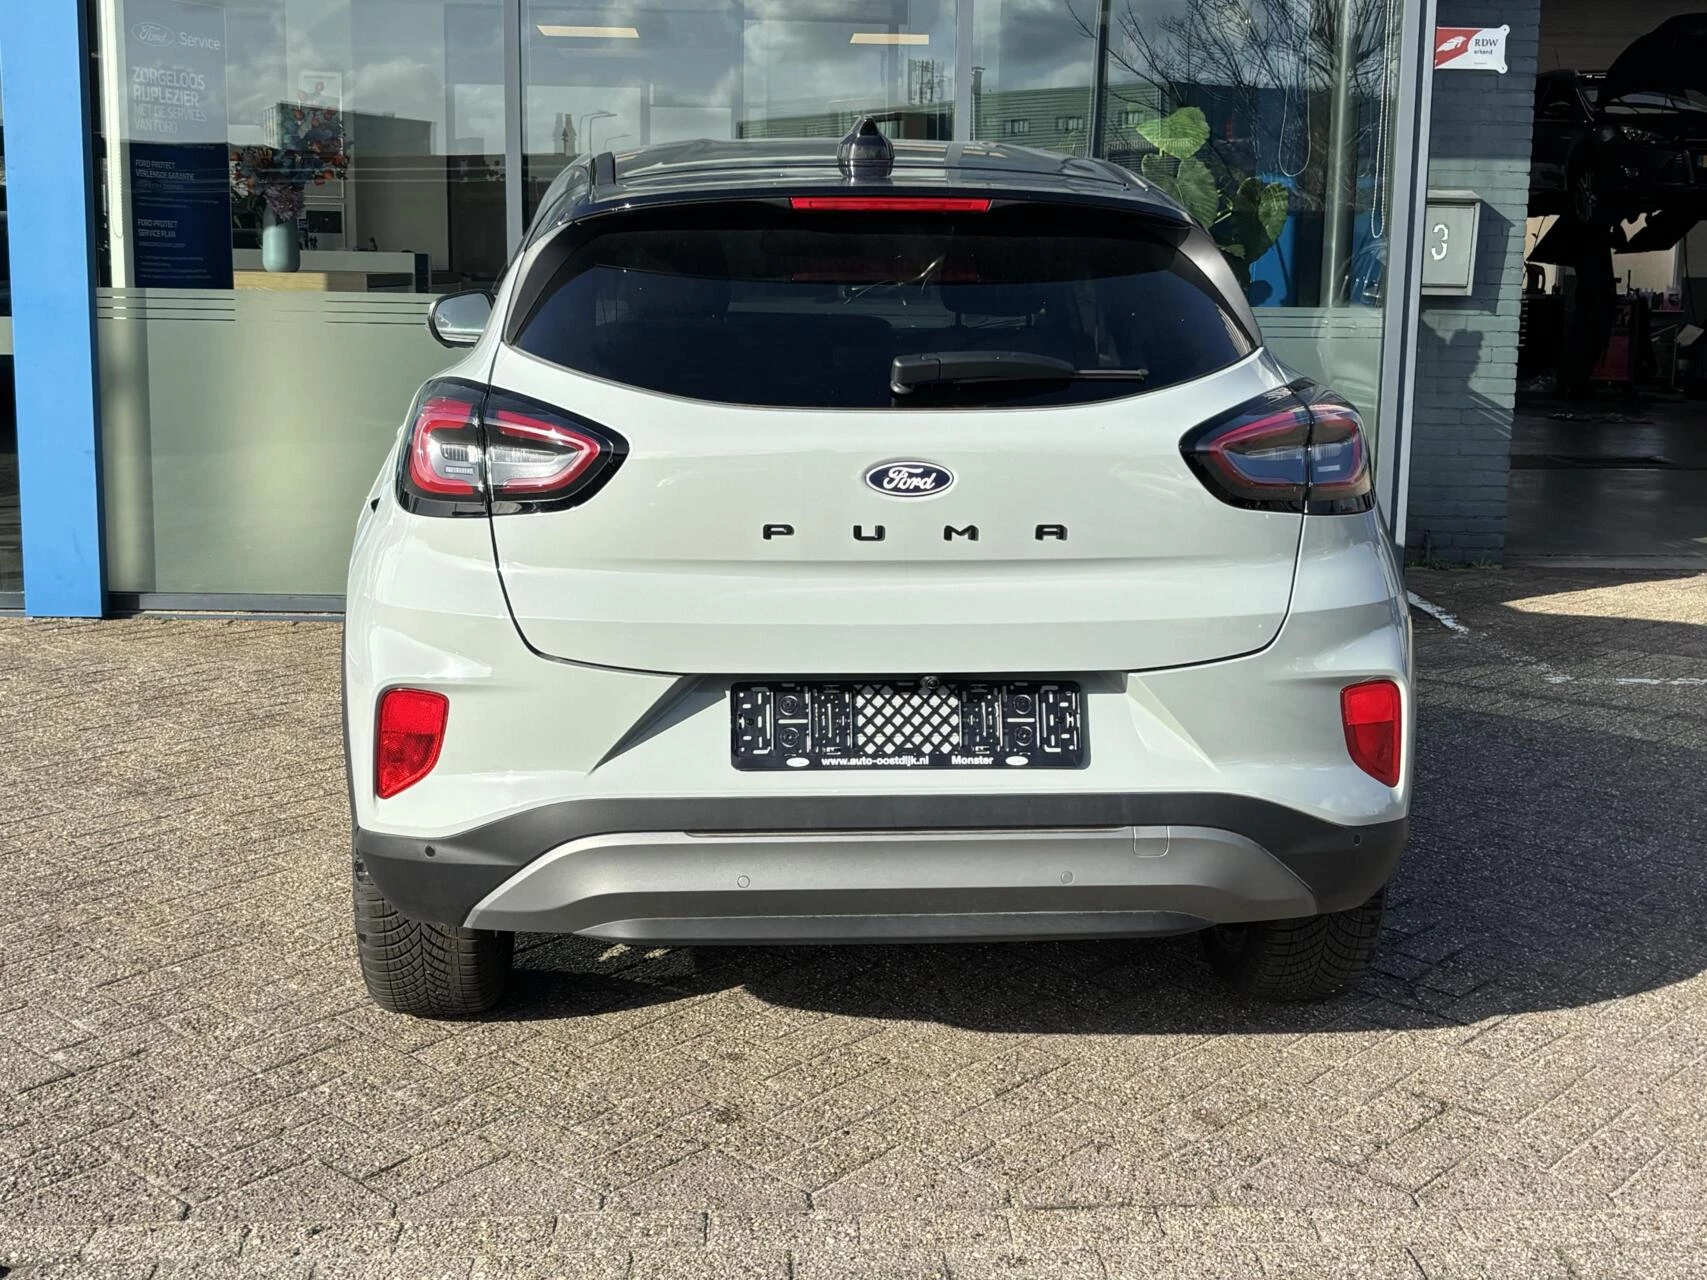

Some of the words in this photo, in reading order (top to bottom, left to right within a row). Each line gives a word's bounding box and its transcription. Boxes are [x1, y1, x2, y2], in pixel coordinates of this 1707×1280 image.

[180, 31, 221, 50] Service
[1474, 38, 1499, 47] RDW
[132, 66, 206, 90] ZORGELOOS
[133, 84, 199, 106] RIJPLEZIER
[134, 103, 152, 117] MET
[154, 105, 167, 118] DE
[167, 106, 207, 122] SERVICES
[134, 118, 153, 131] VAN
[155, 119, 178, 134] FORD
[135, 159, 151, 168] FORD
[151, 161, 176, 169] PROTECT
[1431, 223, 1450, 261] 3
[883, 466, 937, 490] Ford
[762, 524, 1069, 542] PUMA
[821, 755, 930, 767] www.auto-oostdijk.nl
[951, 755, 994, 765] Monster
